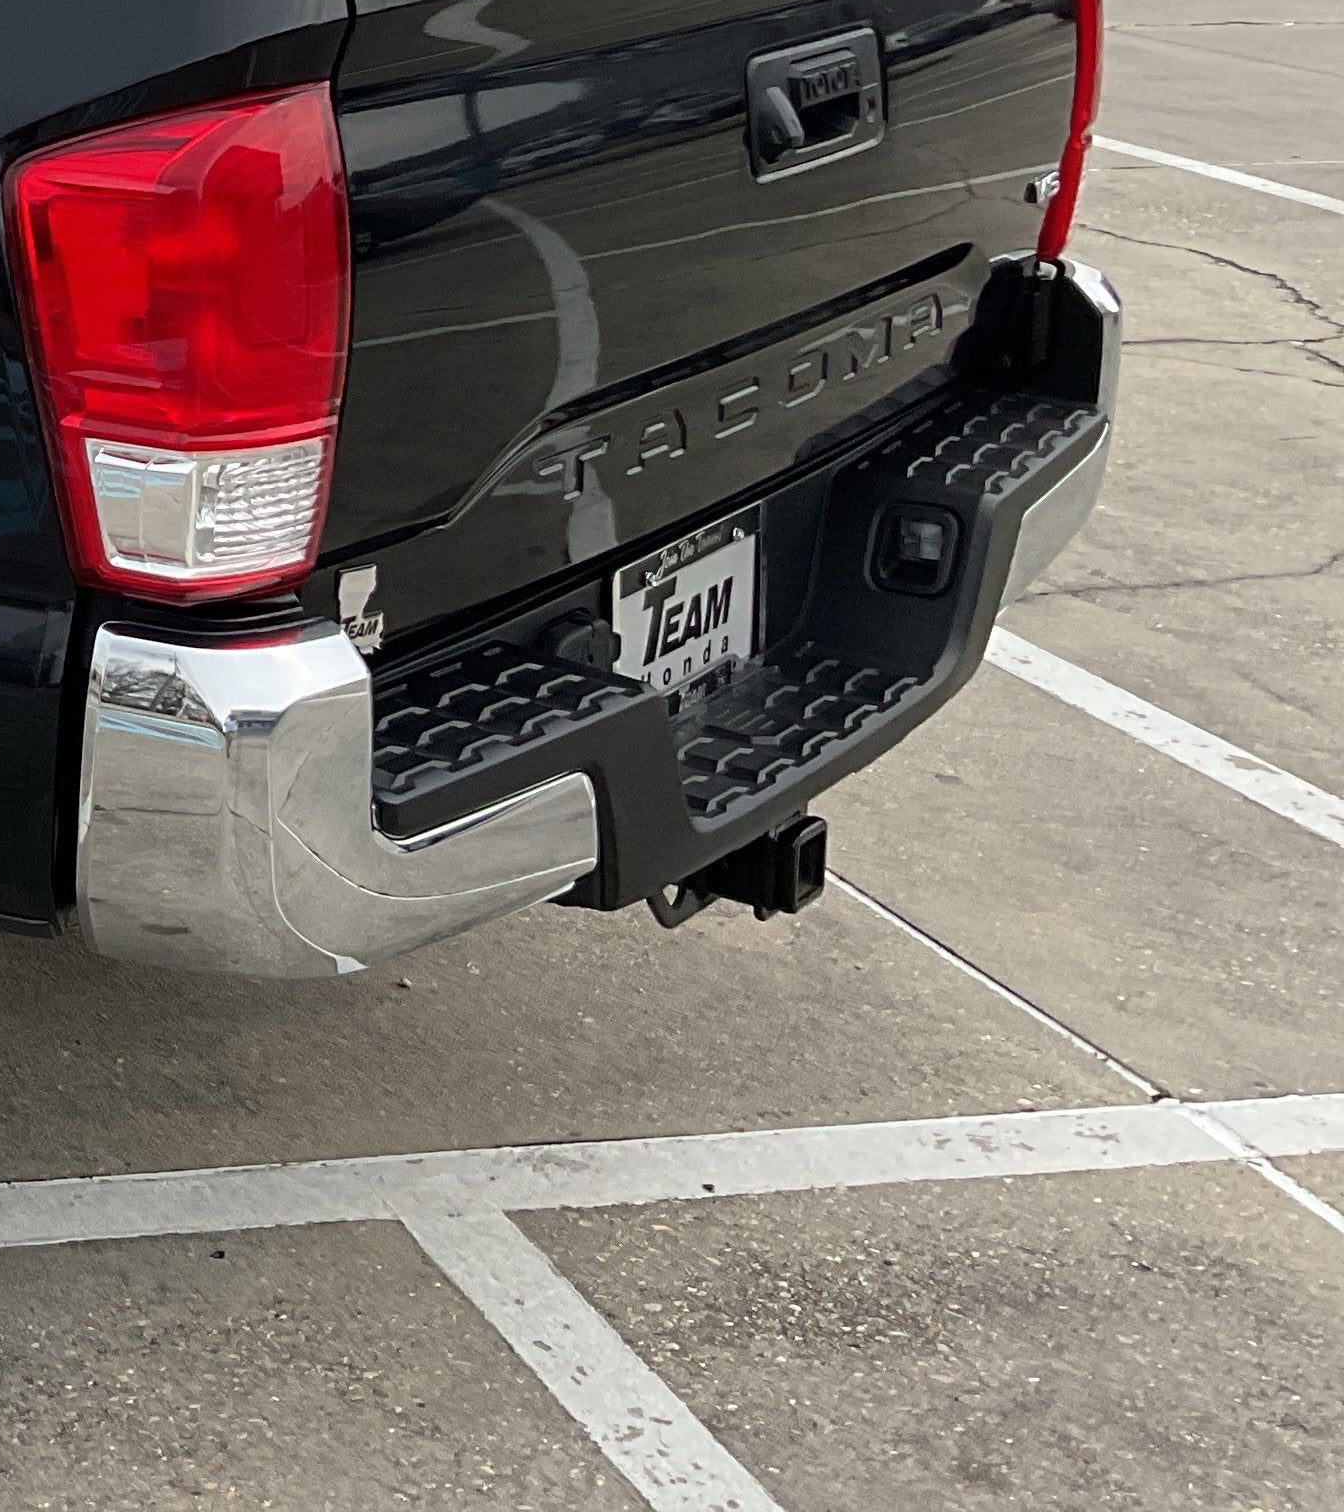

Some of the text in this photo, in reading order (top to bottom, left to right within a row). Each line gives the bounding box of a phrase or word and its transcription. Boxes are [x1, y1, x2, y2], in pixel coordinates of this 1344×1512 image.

[536, 292, 944, 501] TACOMA
[340, 615, 379, 639] TEAM
[642, 576, 734, 667] TEAM
